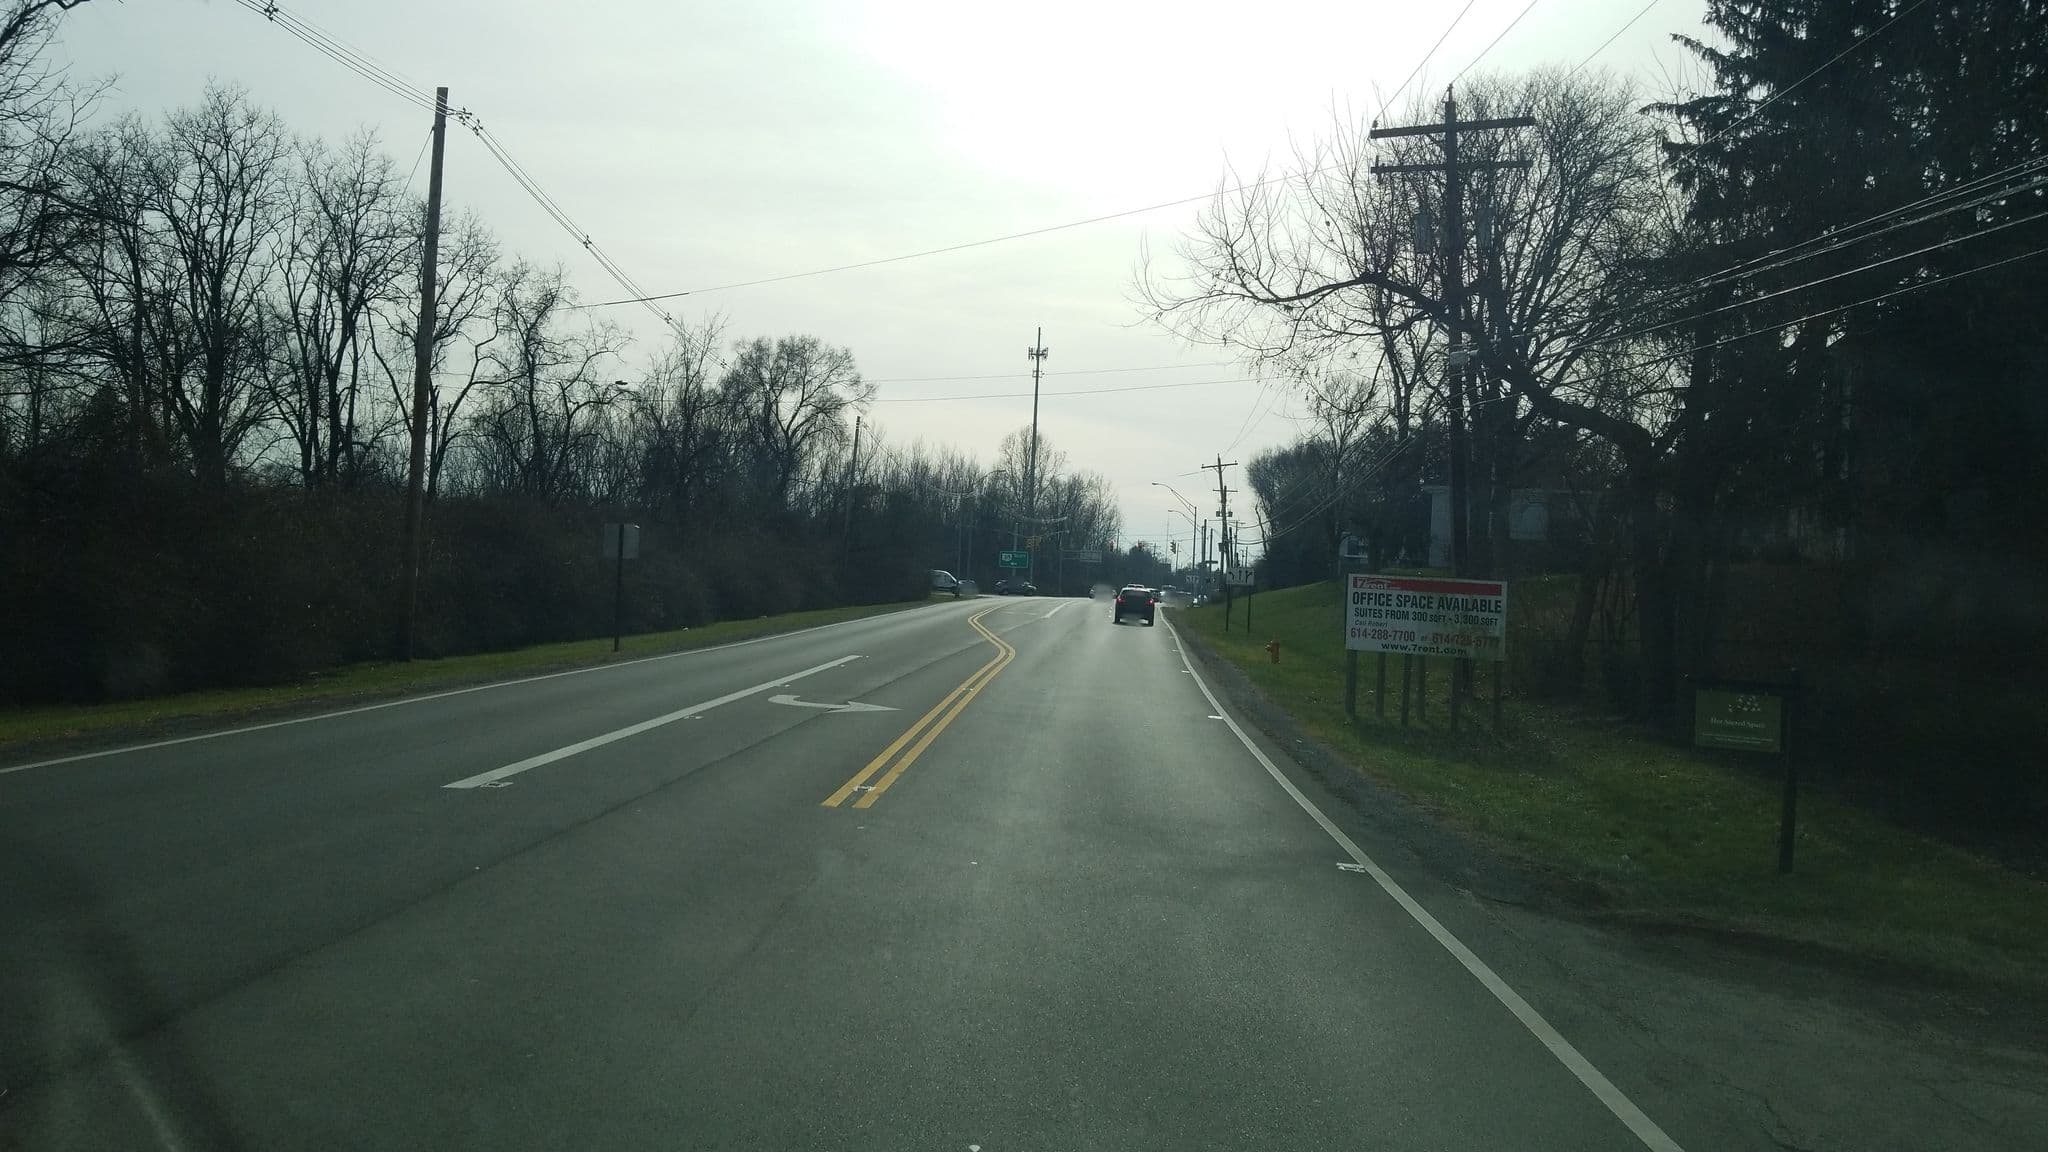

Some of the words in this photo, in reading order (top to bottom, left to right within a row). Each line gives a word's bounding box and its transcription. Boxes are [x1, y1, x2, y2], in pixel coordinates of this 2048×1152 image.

[1352, 591, 1392, 607] OFFICE
[1396, 594, 1433, 610] SPACE
[1437, 596, 1502, 613] AVAILABLE
[1354, 607, 1383, 619] SUITES
[1385, 609, 1409, 621] FROM
[1412, 611, 1428, 622] 300
[1429, 614, 1446, 623] SQFT
[1480, 617, 1498, 626] SQFT
[1351, 627, 1415, 642] 614-288-7700
[1381, 642, 1467, 655] www.7rent.com
